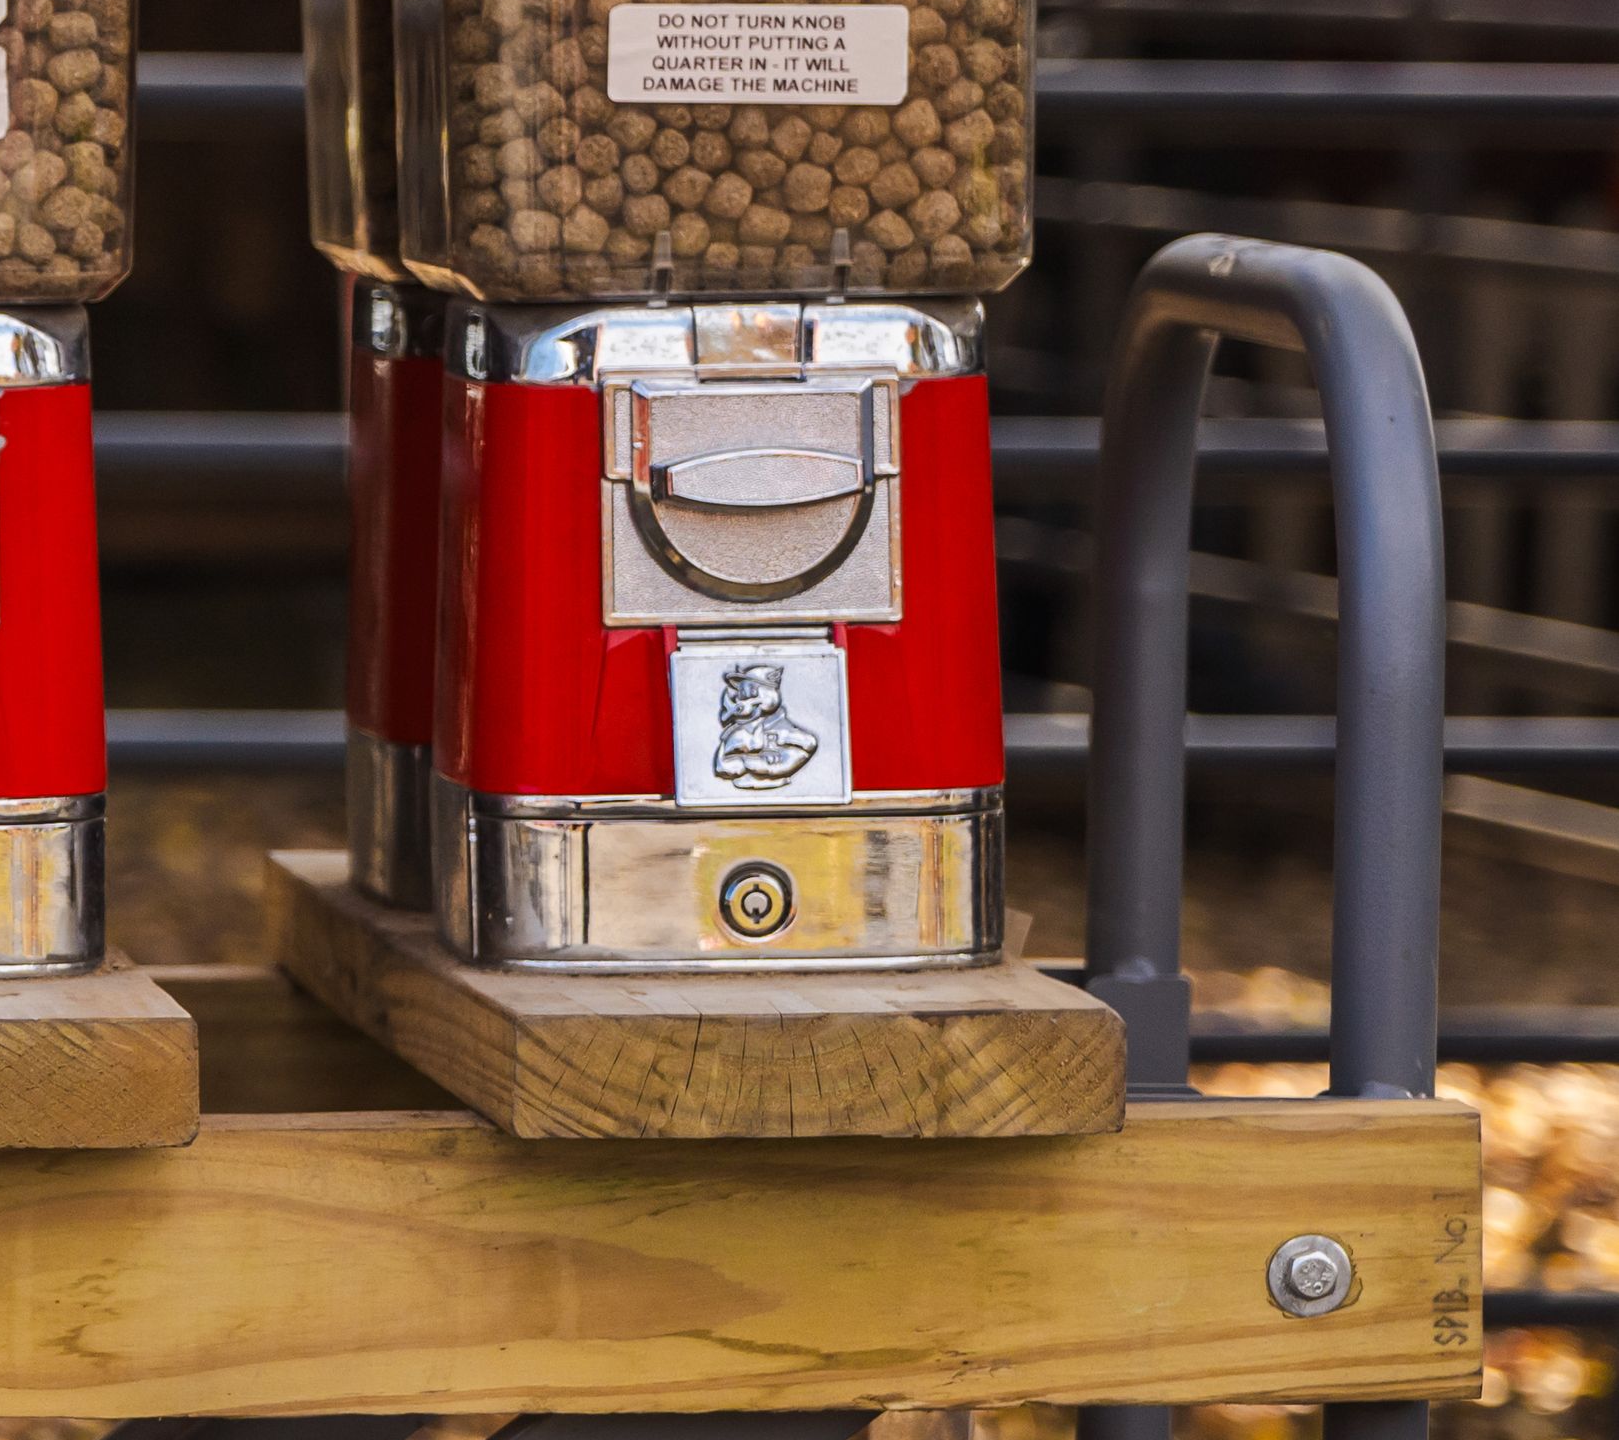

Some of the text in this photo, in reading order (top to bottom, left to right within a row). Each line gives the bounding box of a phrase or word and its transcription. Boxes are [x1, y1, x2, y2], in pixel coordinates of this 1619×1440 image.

[658, 13, 846, 31] DO NOT TURN KNOB
[656, 34, 846, 52] WITHOUT PUTTING A
[651, 55, 744, 72] QUARTER
[749, 57, 767, 72] IN
[784, 56, 800, 72] IT
[804, 57, 850, 73] WILL
[642, 76, 858, 94] DAMAGE THE MACHINE
